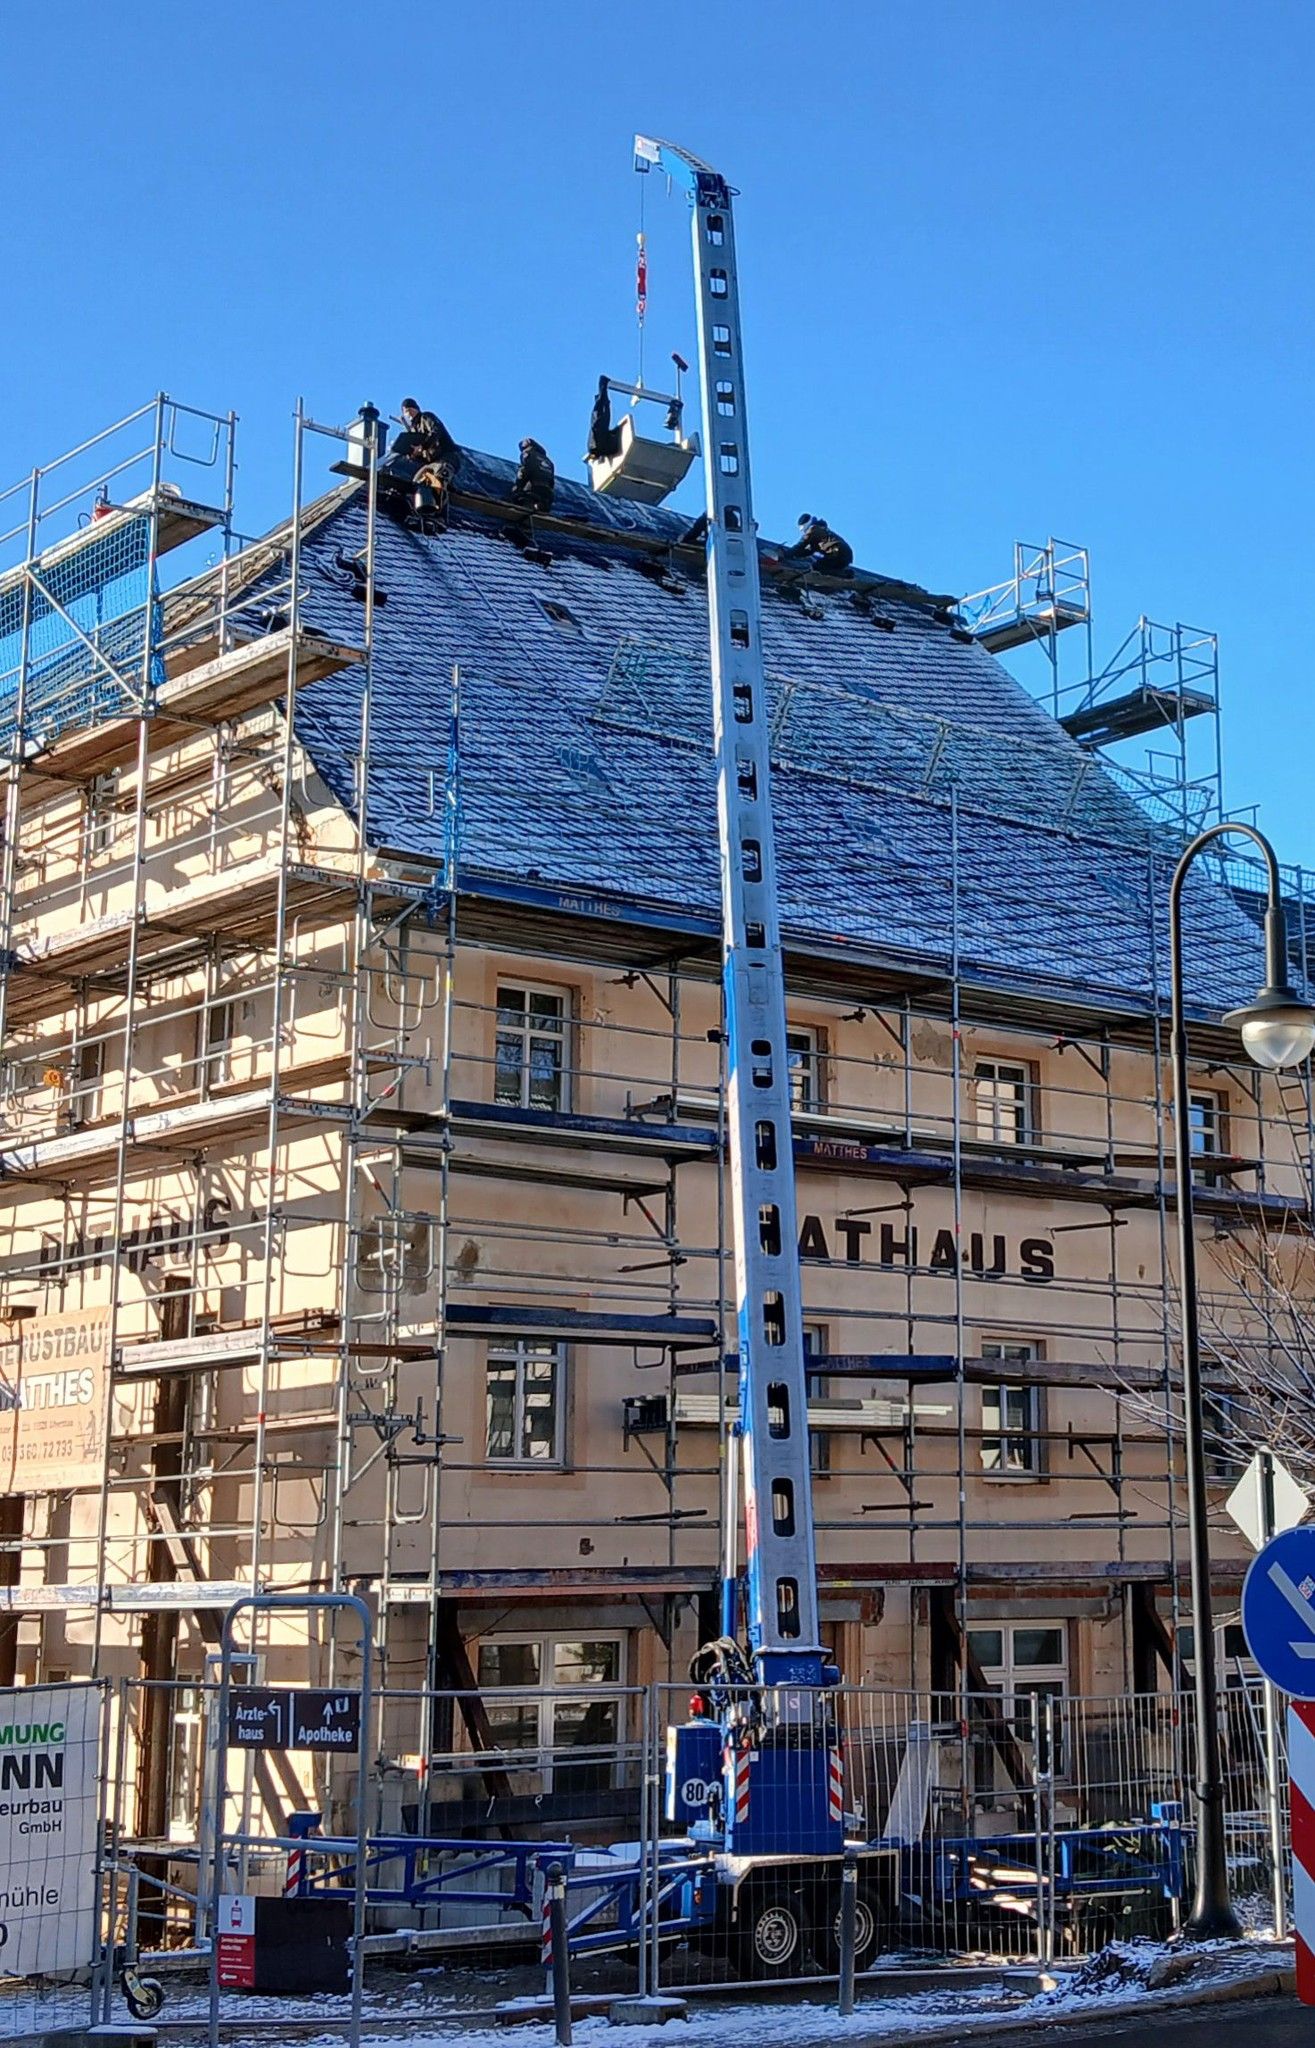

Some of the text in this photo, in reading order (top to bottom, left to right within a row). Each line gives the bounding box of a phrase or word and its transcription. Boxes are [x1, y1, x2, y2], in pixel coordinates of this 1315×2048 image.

[559, 896, 621, 916] MATTHES
[814, 1142, 868, 1159] MATTHES
[238, 1724, 265, 1740] haus
[298, 1725, 353, 1745] Apotheke
[1, 1752, 64, 1791] NN
[686, 1782, 705, 1802] 80
[19, 1819, 62, 1835] GmbH
